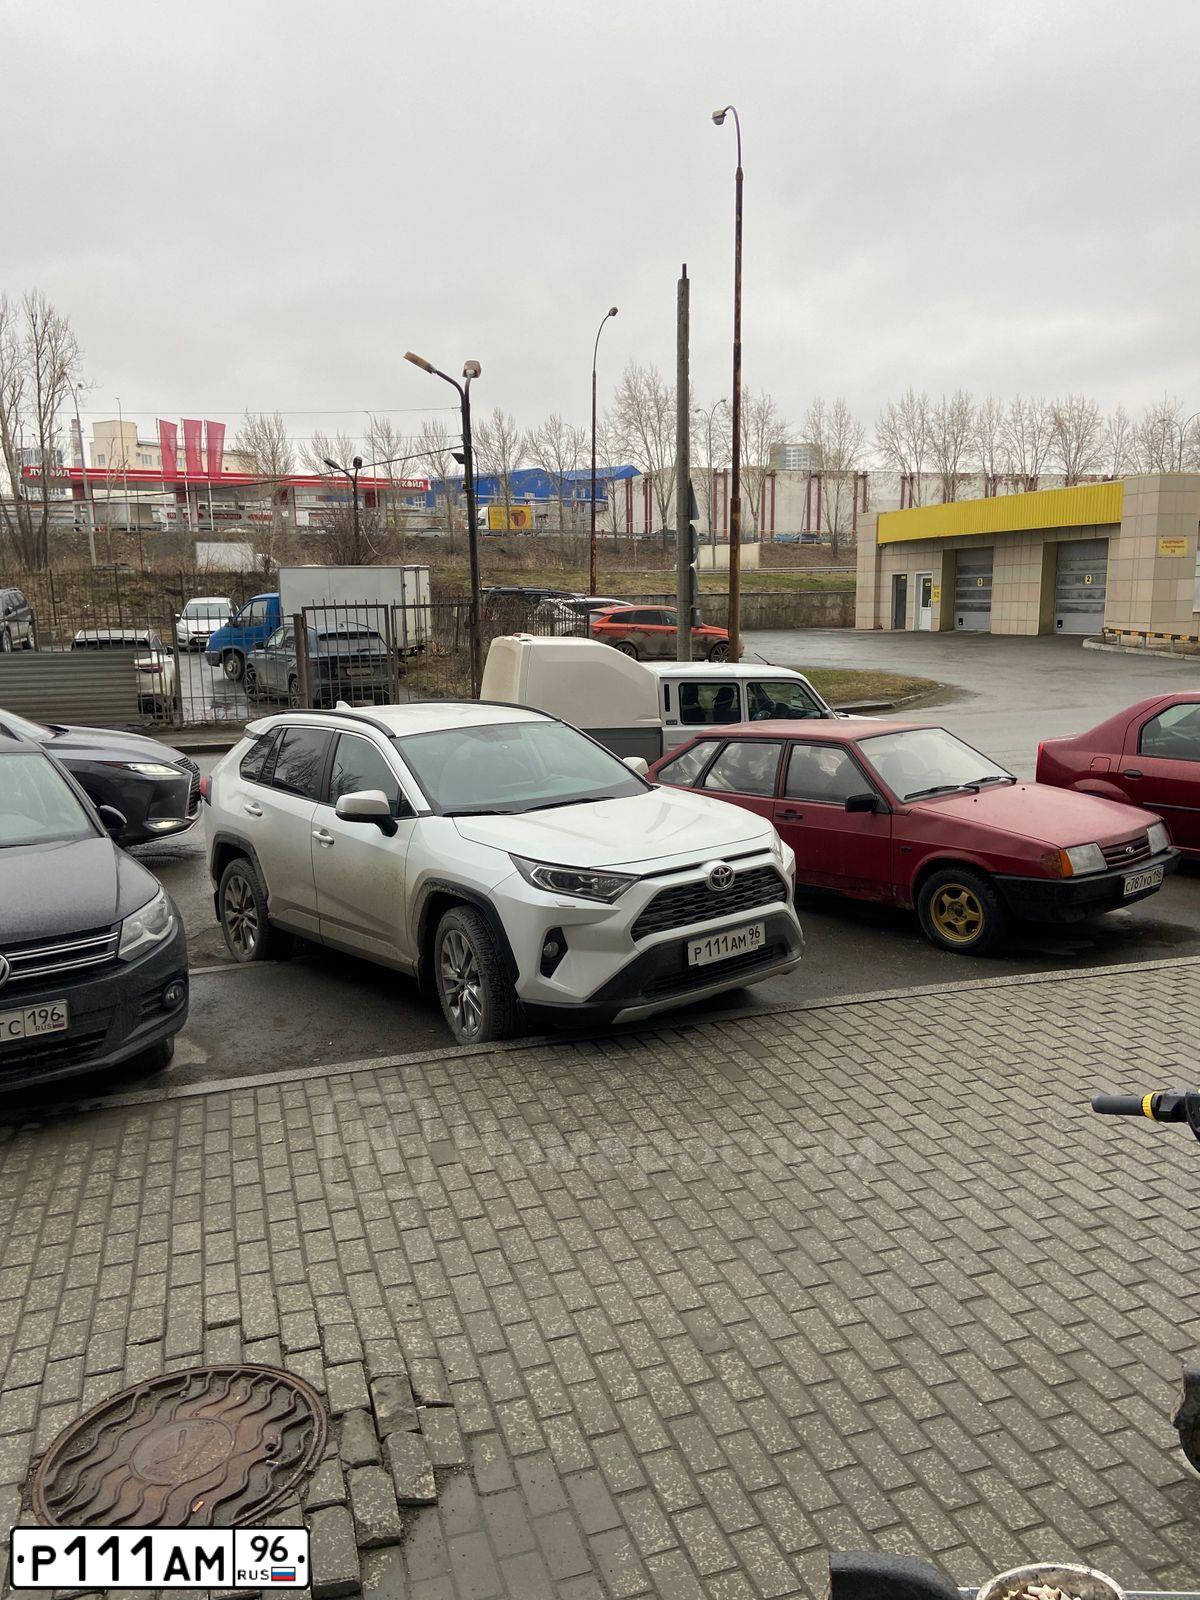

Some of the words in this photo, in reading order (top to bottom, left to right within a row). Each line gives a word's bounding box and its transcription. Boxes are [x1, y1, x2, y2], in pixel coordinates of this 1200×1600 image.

[29, 468, 71, 478] ЛУОЙЛ
[694, 934, 747, 961] Р111АМ
[748, 925, 760, 940] 96
[27, 1006, 61, 1026] 196
[35, 1023, 53, 1032] RUS
